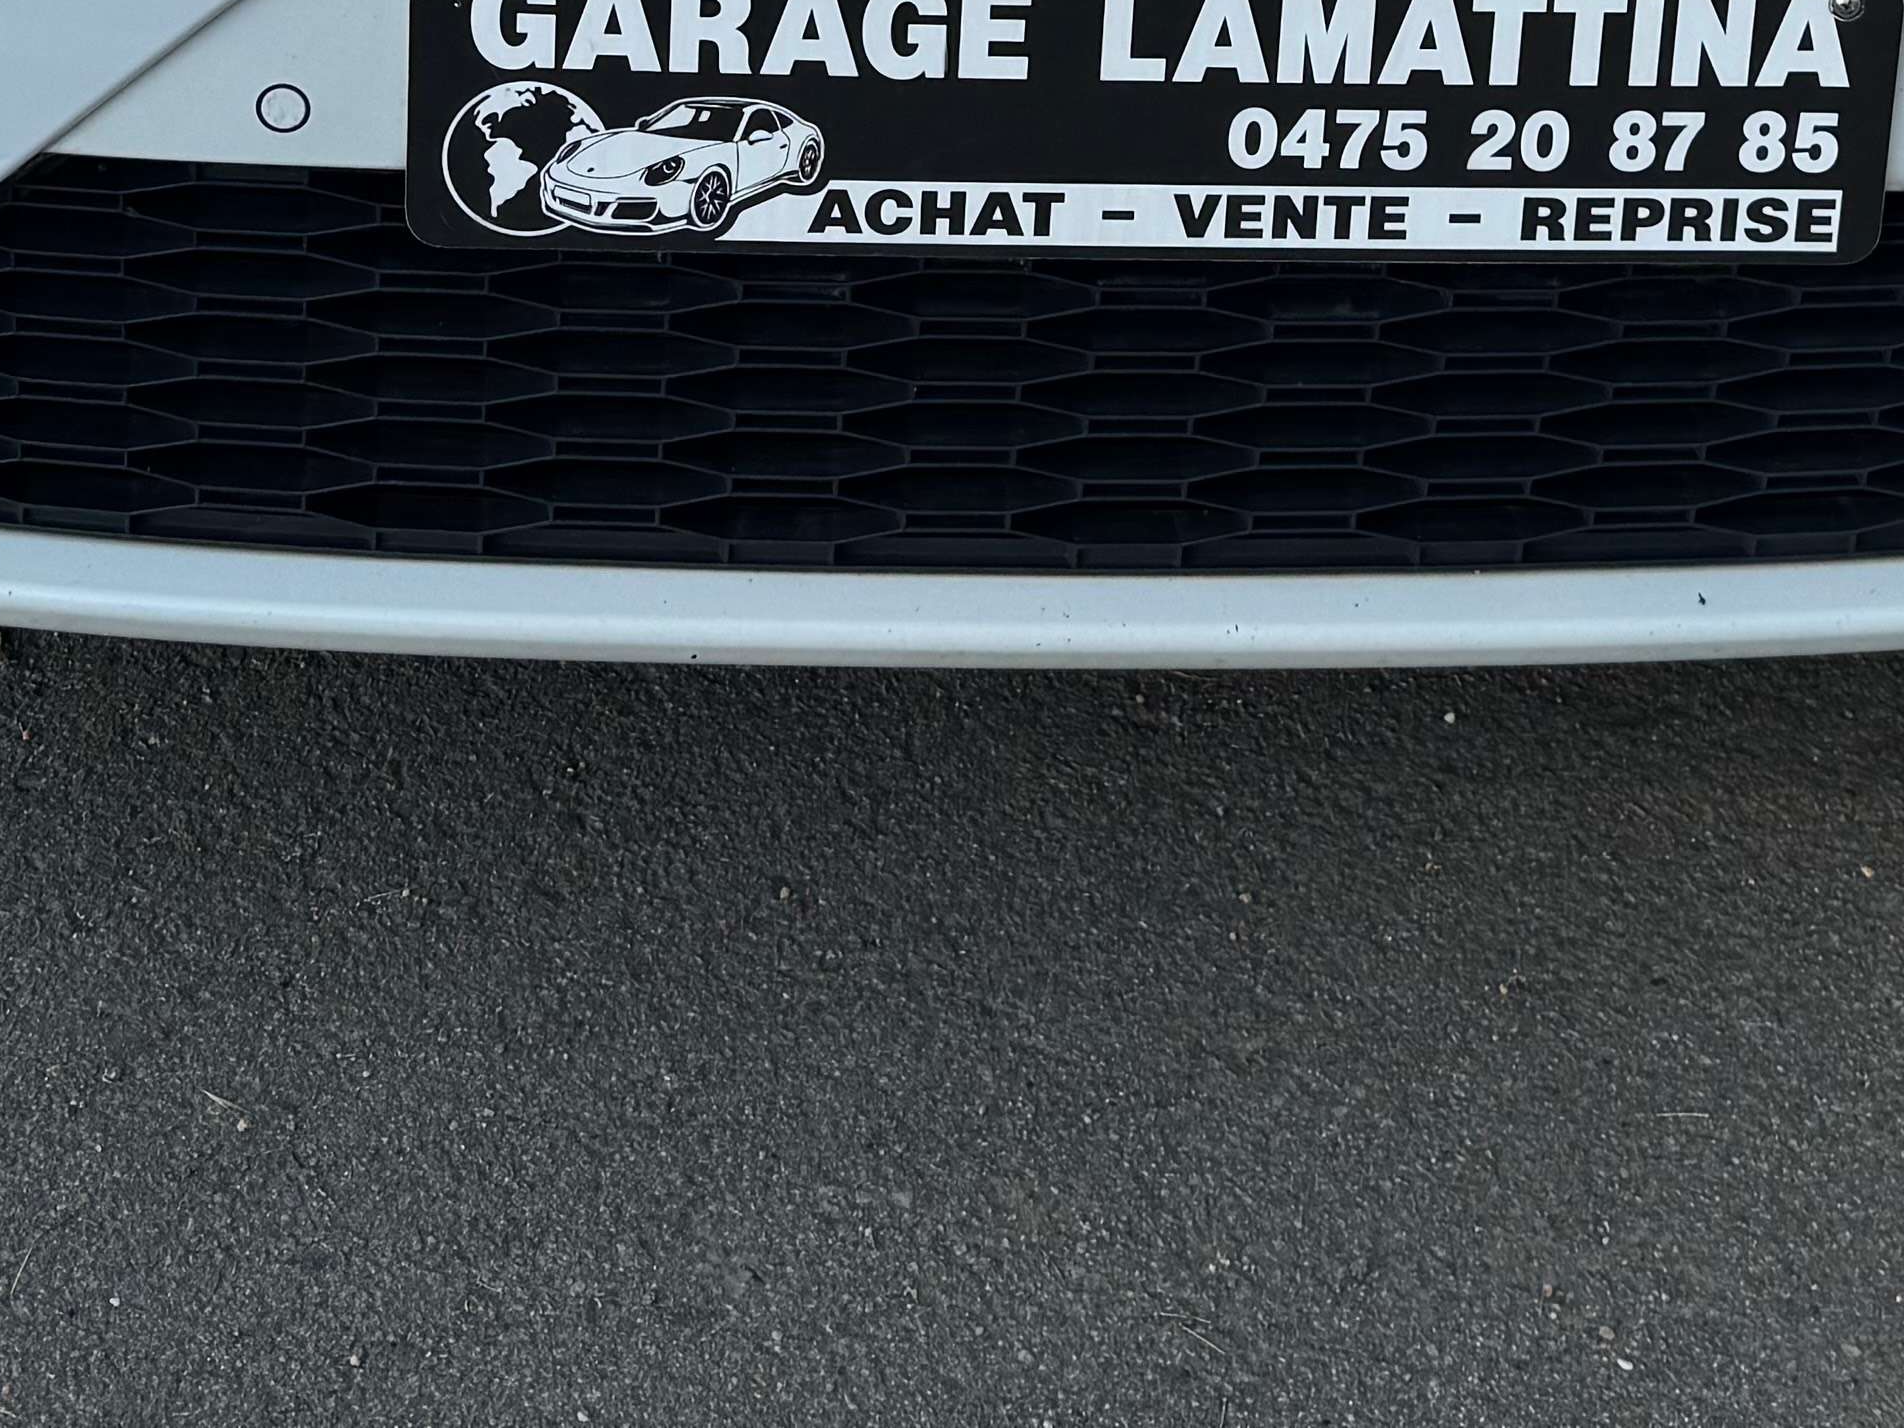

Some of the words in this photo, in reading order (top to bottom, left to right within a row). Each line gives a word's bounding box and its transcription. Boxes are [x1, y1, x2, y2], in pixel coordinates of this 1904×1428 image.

[1228, 107, 1428, 173] 0475
[1466, 108, 1569, 172] 20
[1608, 109, 1705, 173] 87
[1738, 110, 1840, 175] 85
[807, 189, 1066, 239] ACHAT
[1176, 194, 1410, 241] VENTE
[1520, 195, 1837, 244] REPRISE
